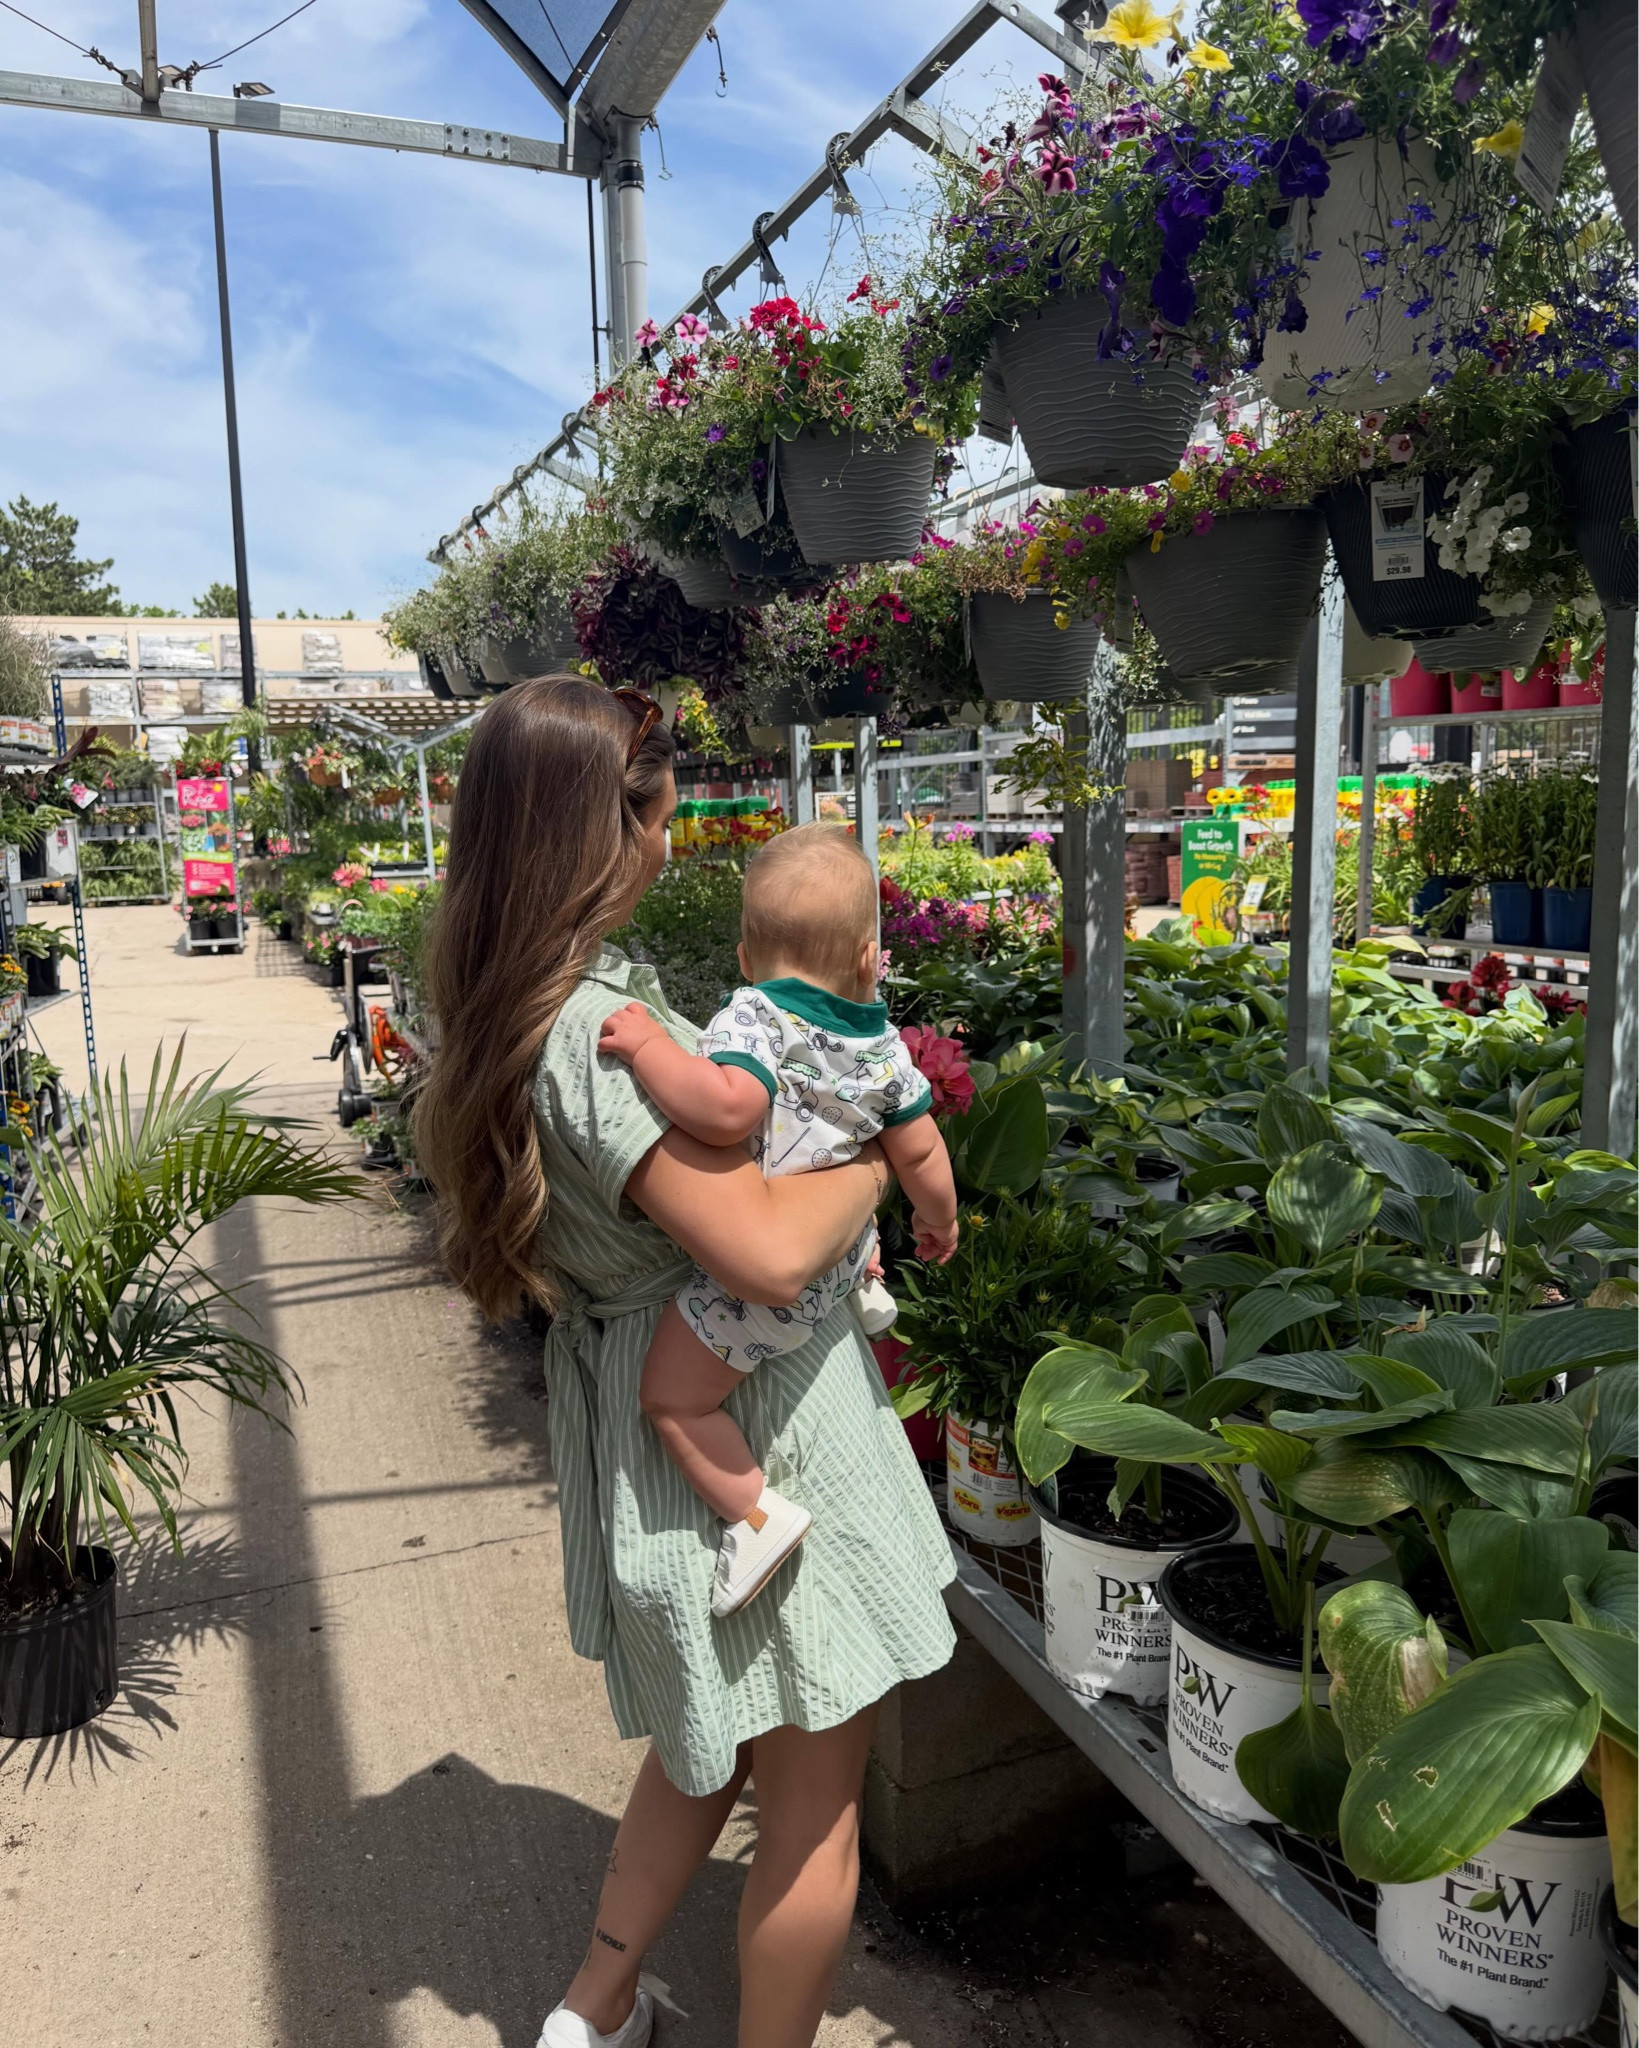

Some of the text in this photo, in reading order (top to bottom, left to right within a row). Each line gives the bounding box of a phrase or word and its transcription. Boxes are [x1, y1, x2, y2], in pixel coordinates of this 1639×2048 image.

[1386, 566, 1412, 576] $29.98
[1197, 828, 1223, 840] Feed to
[1188, 839, 1234, 851] Boost Growth
[973, 1440, 996, 1452] Vigoro
[954, 1489, 980, 1511] Vigoro
[996, 1505, 1031, 1517] Vigoro
[1095, 1628, 1172, 1648] WINNERS
[1097, 1647, 1112, 1660] The
[1113, 1650, 1124, 1660] #1
[1126, 1652, 1147, 1663] Plant
[1175, 1640, 1237, 1718] PW
[1175, 1687, 1224, 1738] PROVEN
[1186, 1738, 1202, 1759] Plant
[1445, 1908, 1543, 1950] PROVEN
[1437, 1948, 1458, 1967] The
[1459, 1959, 1474, 1974] #1
[1477, 1965, 1507, 1984] Plant
